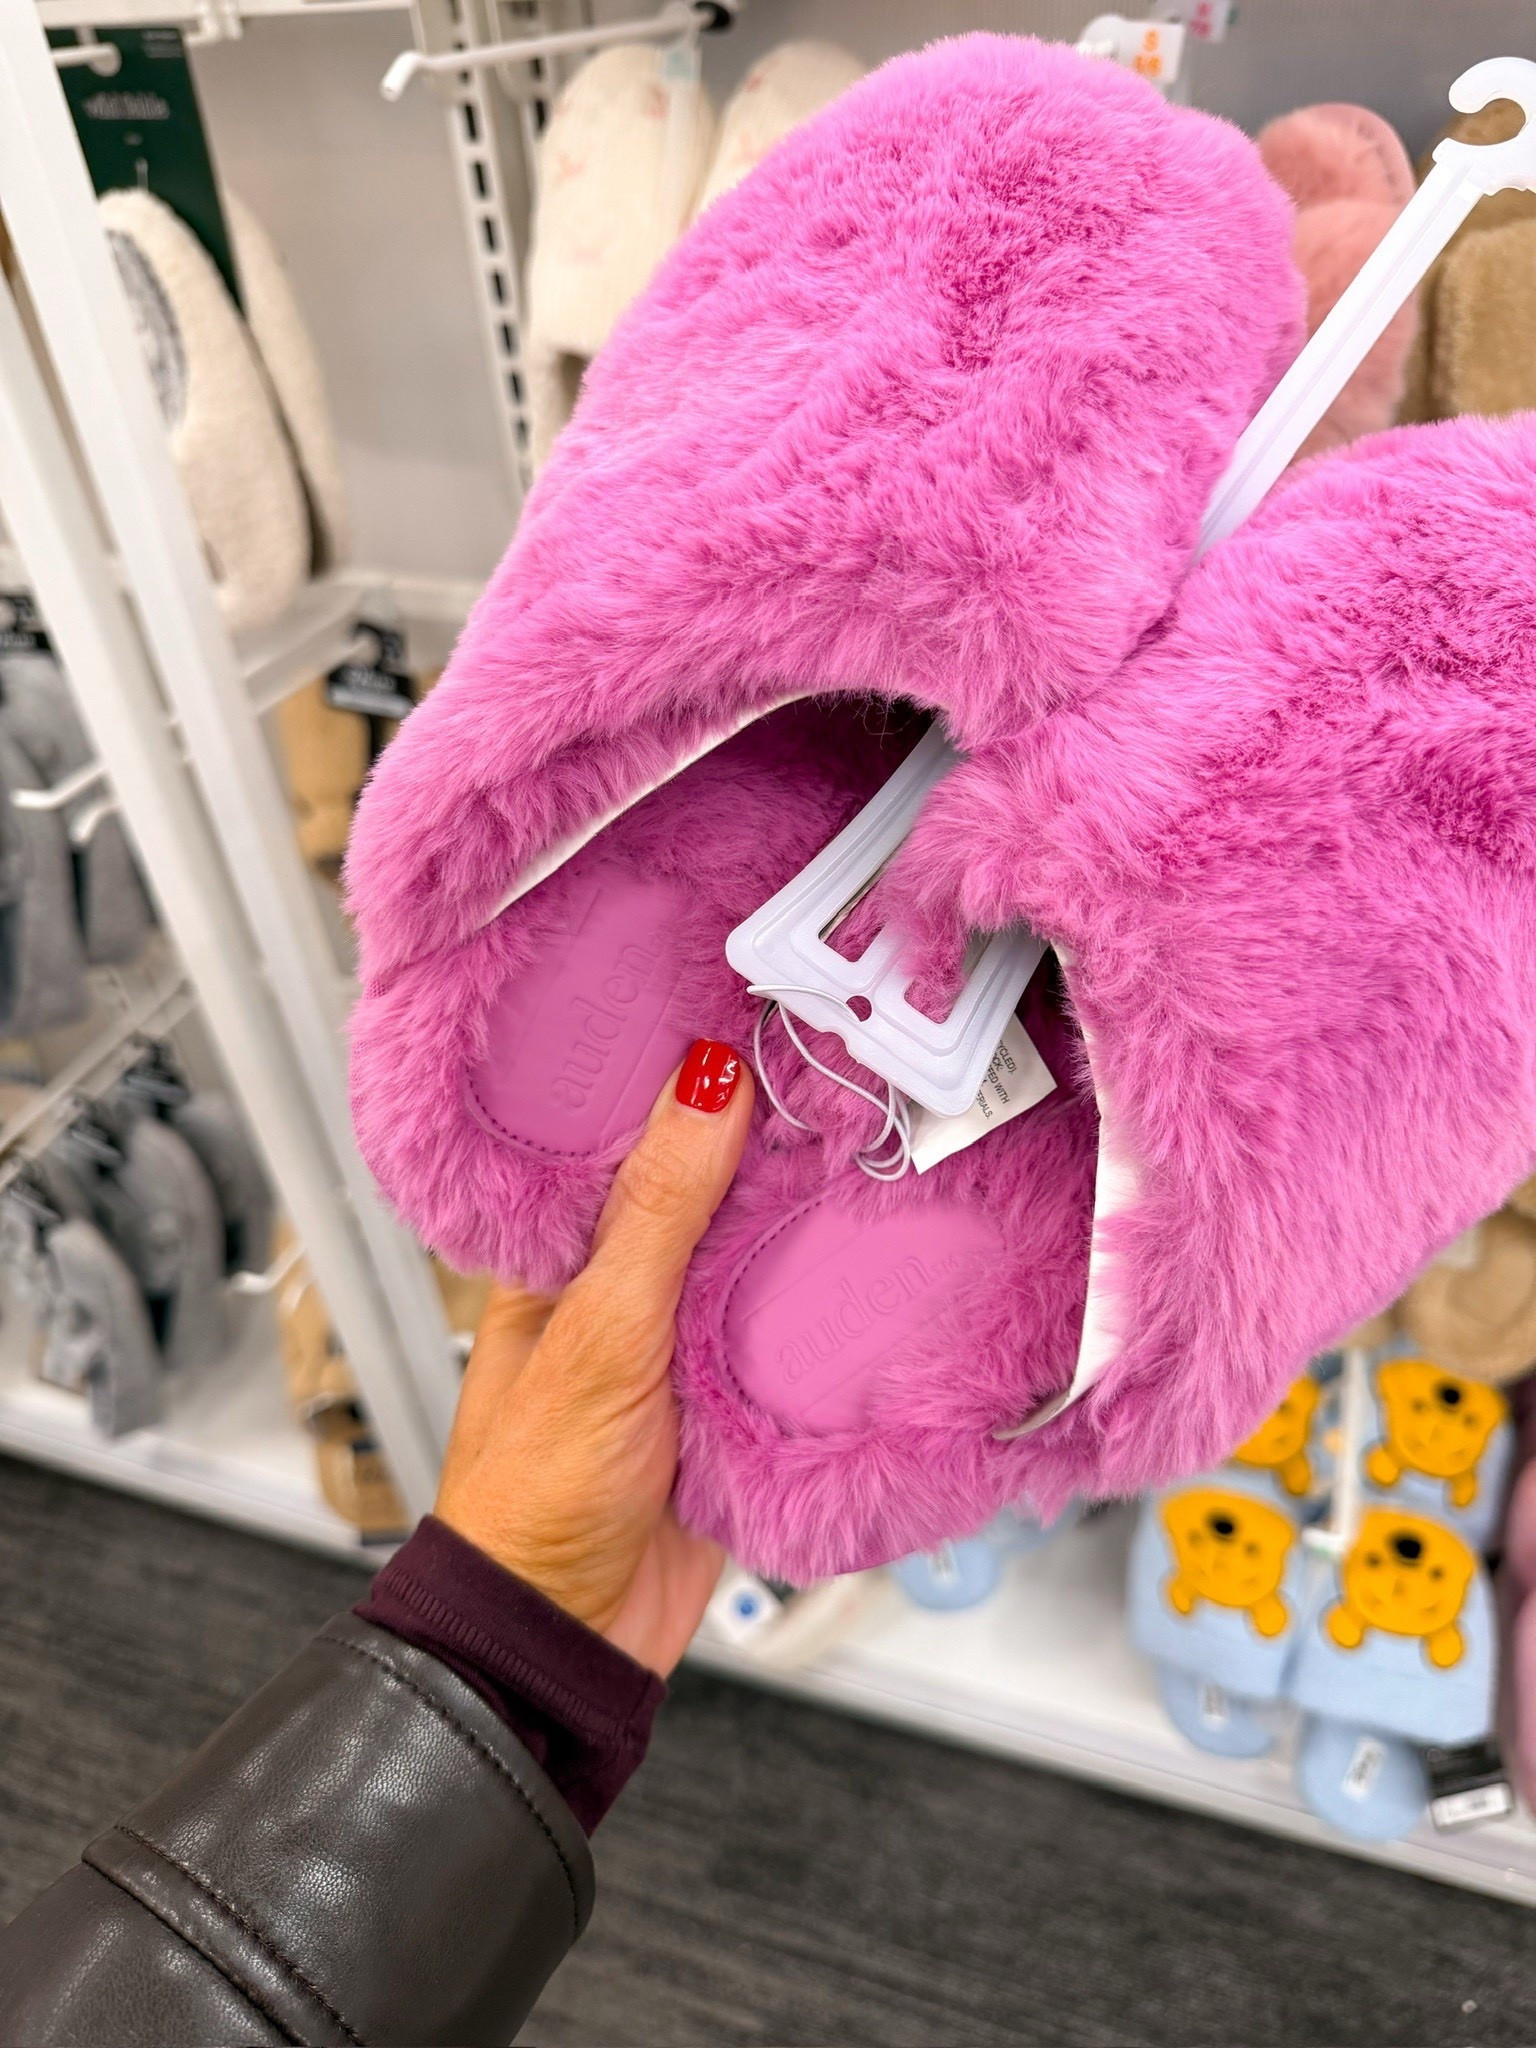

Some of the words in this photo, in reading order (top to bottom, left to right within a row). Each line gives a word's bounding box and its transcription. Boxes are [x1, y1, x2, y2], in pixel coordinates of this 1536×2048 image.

[550, 943, 661, 1114] auden
[998, 1040, 1017, 1075] YCLED).
[987, 1064, 999, 1084] FED
[994, 1082, 1010, 1104] WITH
[976, 1089, 993, 1120] ERIALS.
[775, 1255, 937, 1386] auden
